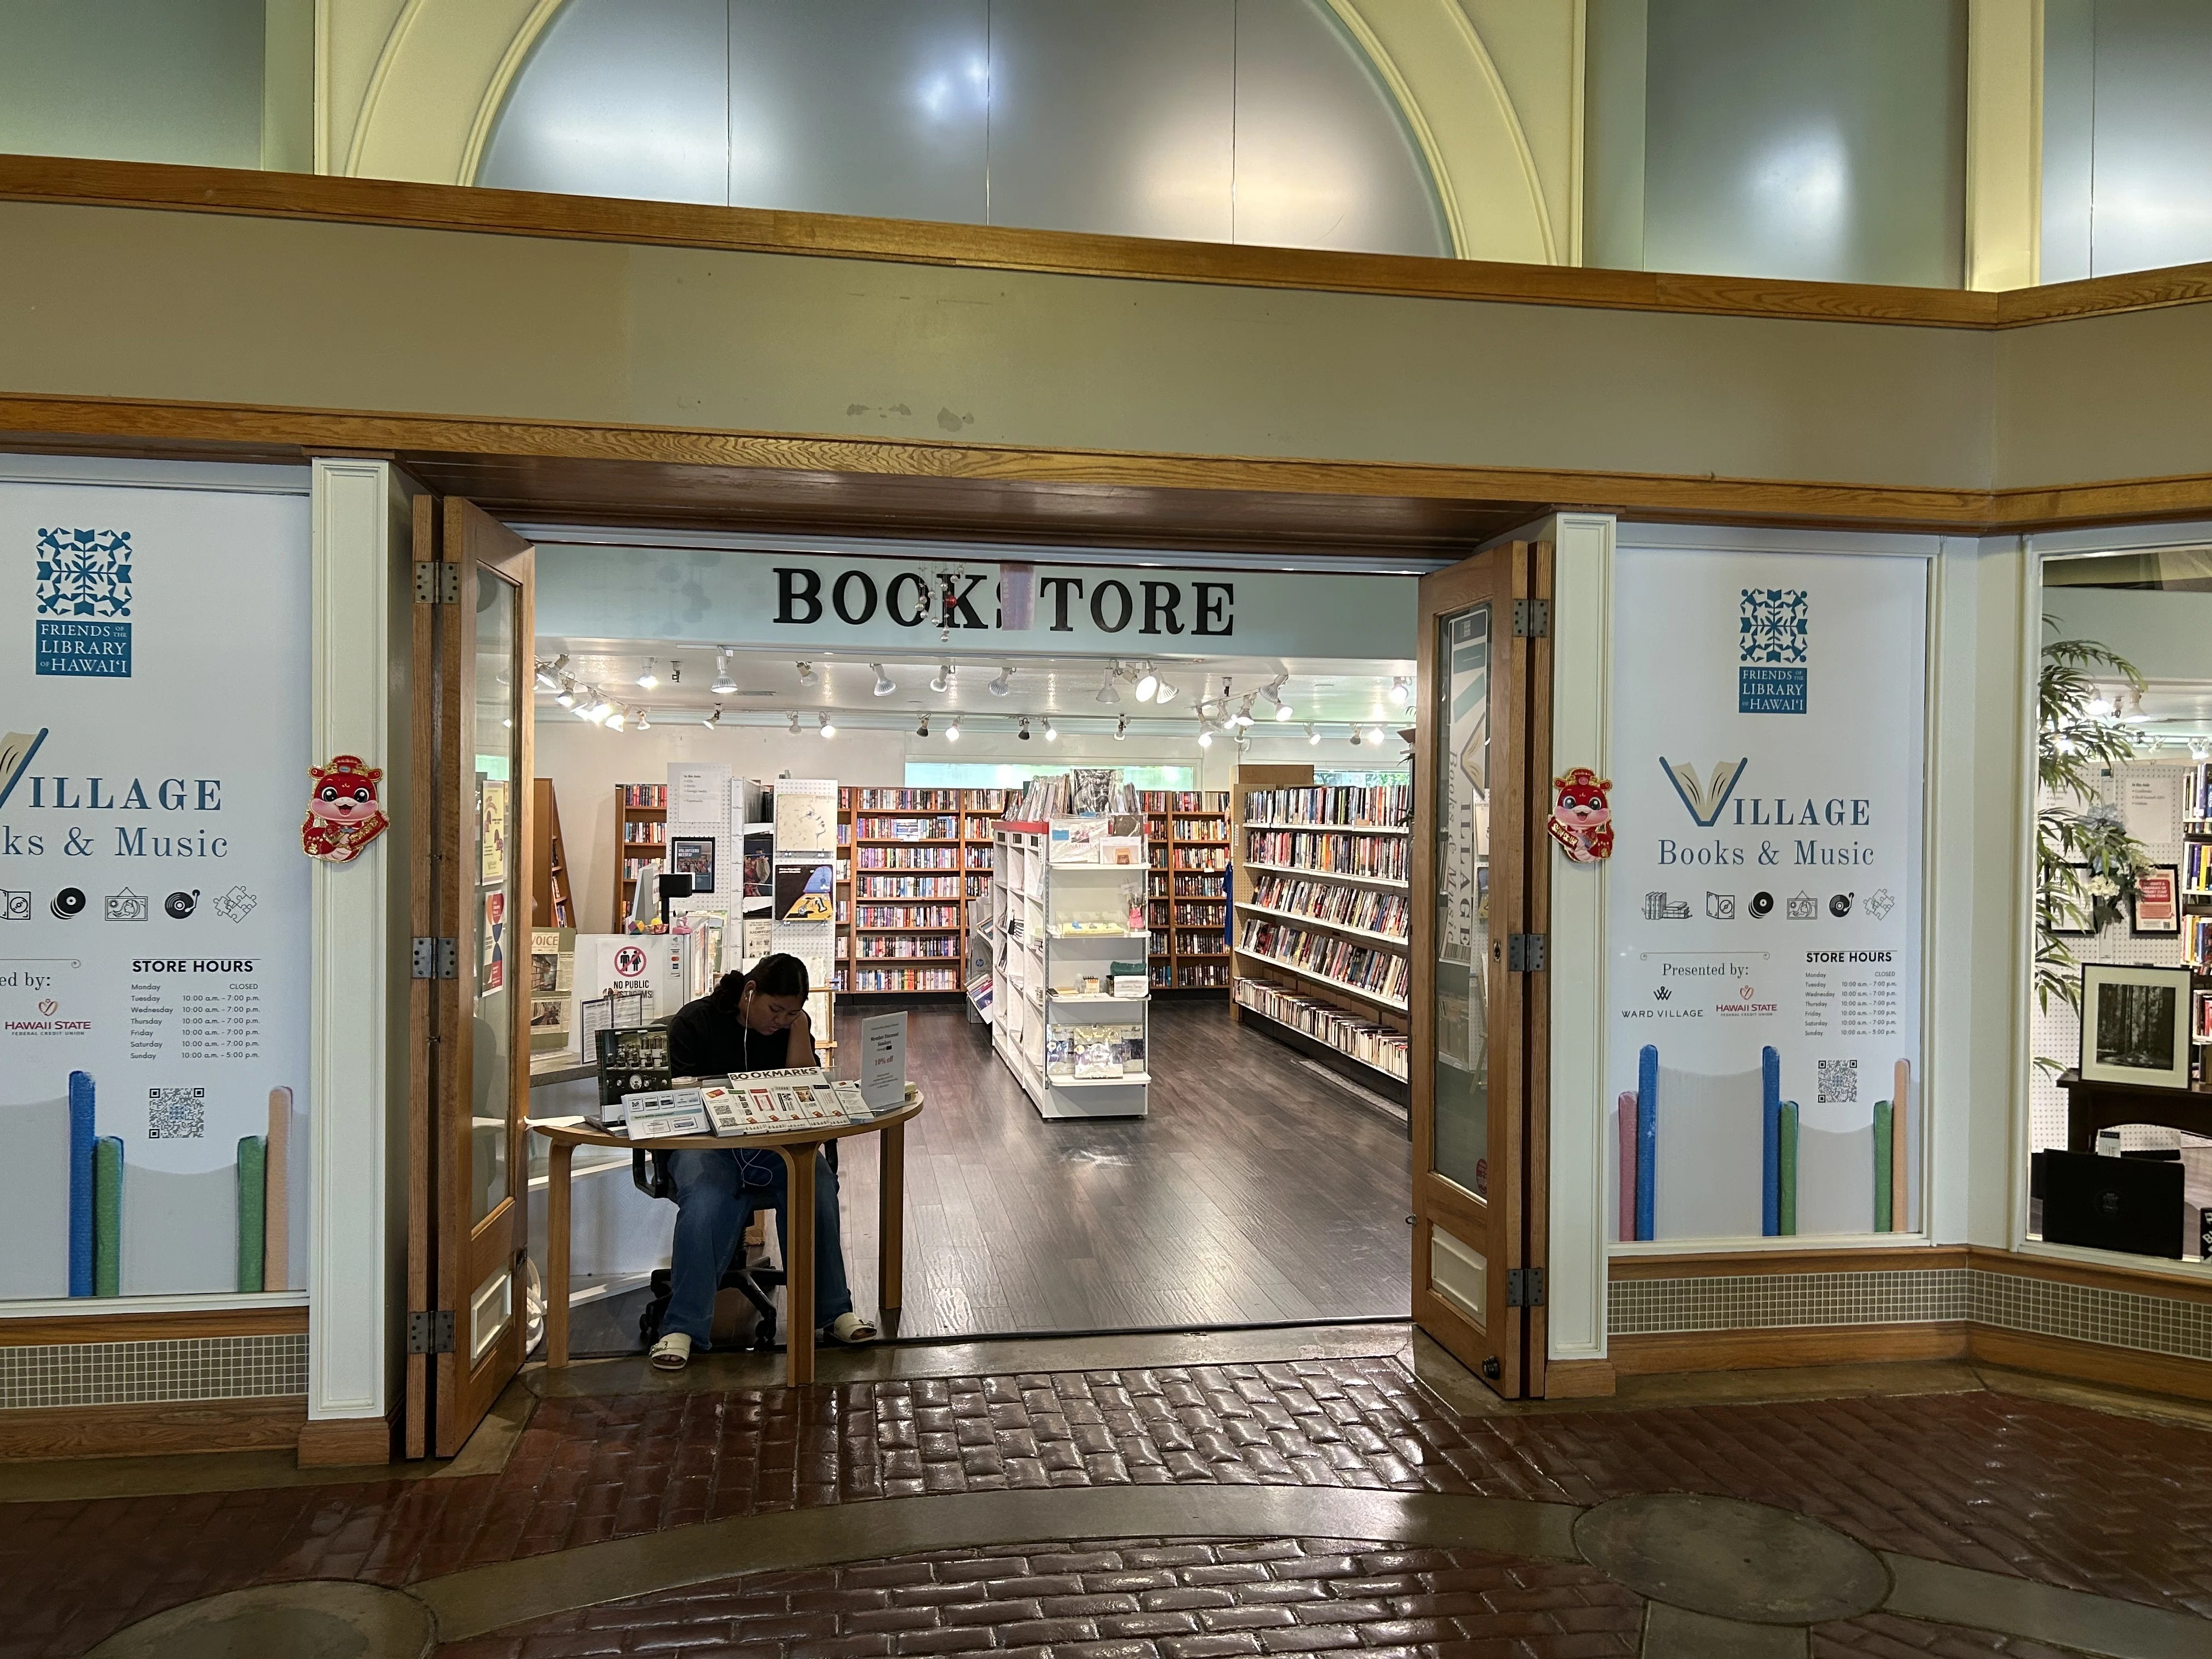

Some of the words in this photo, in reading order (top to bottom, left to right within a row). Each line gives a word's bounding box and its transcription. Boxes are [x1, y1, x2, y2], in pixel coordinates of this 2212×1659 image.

[772, 567, 1235, 637] BOOKTORE
[41, 624, 111, 637] FRIENDS
[41, 640, 127, 656] LIBRARY
[1742, 670, 1792, 680] FRIENDS
[1742, 683, 1803, 696] LIBRARY
[64, 827, 94, 856] &
[114, 827, 228, 857] Music
[1658, 839, 1745, 866] Books
[1758, 840, 1780, 866] &
[1794, 840, 1874, 866] Music
[1806, 952, 1844, 963] STORE
[1849, 952, 1892, 962] HOURS
[132, 960, 187, 973] STORE
[193, 960, 253, 973] HOURS
[1662, 963, 1725, 976] Presented
[1730, 963, 1749, 979] by:
[24, 972, 50, 991] by:
[613, 980, 623, 989] NO
[625, 980, 650, 989] PUBLIC
[131, 984, 161, 992] Monday
[131, 1006, 173, 1014] Wednesday
[1622, 1010, 1654, 1018] WARD
[1657, 1009, 1703, 1018] VILLAGE
[5, 1021, 52, 1030] HAWAII
[54, 1021, 92, 1030] STATE
[131, 1018, 162, 1026] Thursday
[131, 1029, 154, 1037] Friday
[131, 1041, 163, 1049] Saturday
[130, 1052, 156, 1060] Sunday
[874, 1057, 886, 1066] 10%
[886, 1055, 894, 1063] off
